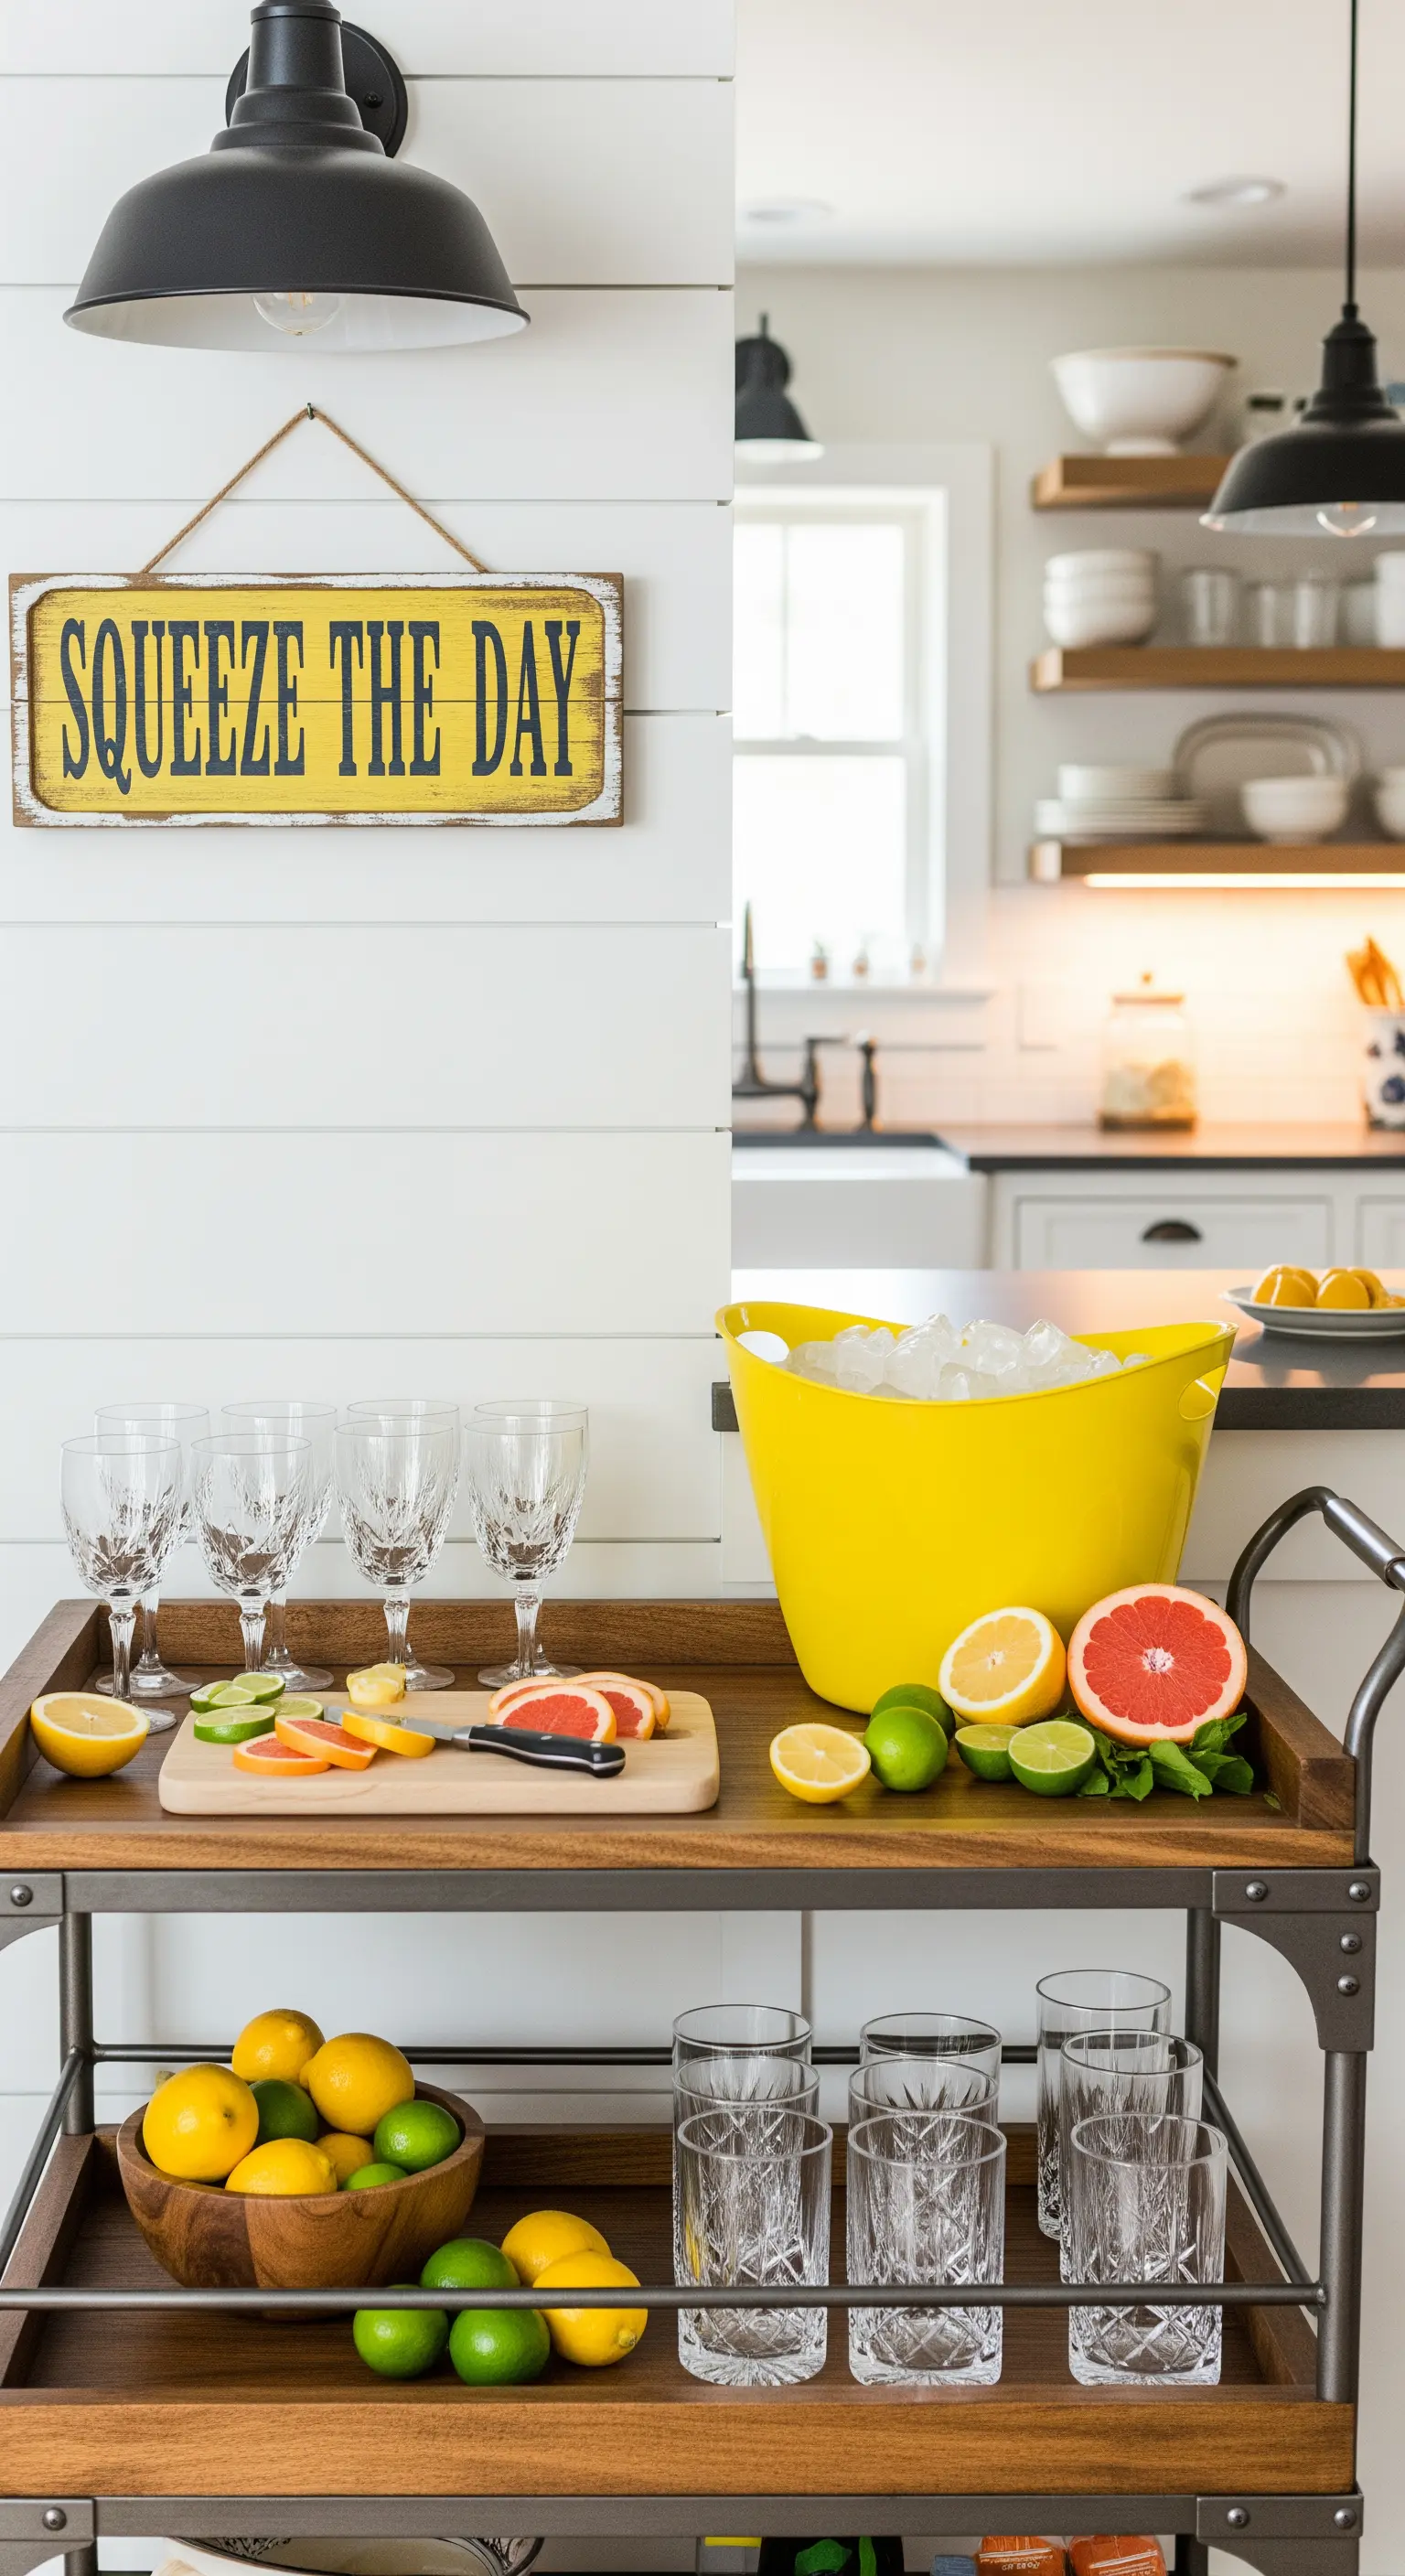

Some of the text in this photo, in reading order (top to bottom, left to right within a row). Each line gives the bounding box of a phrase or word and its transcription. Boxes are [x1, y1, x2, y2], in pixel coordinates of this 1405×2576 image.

[60, 618, 581, 795] SQUEEZE THE DAY
